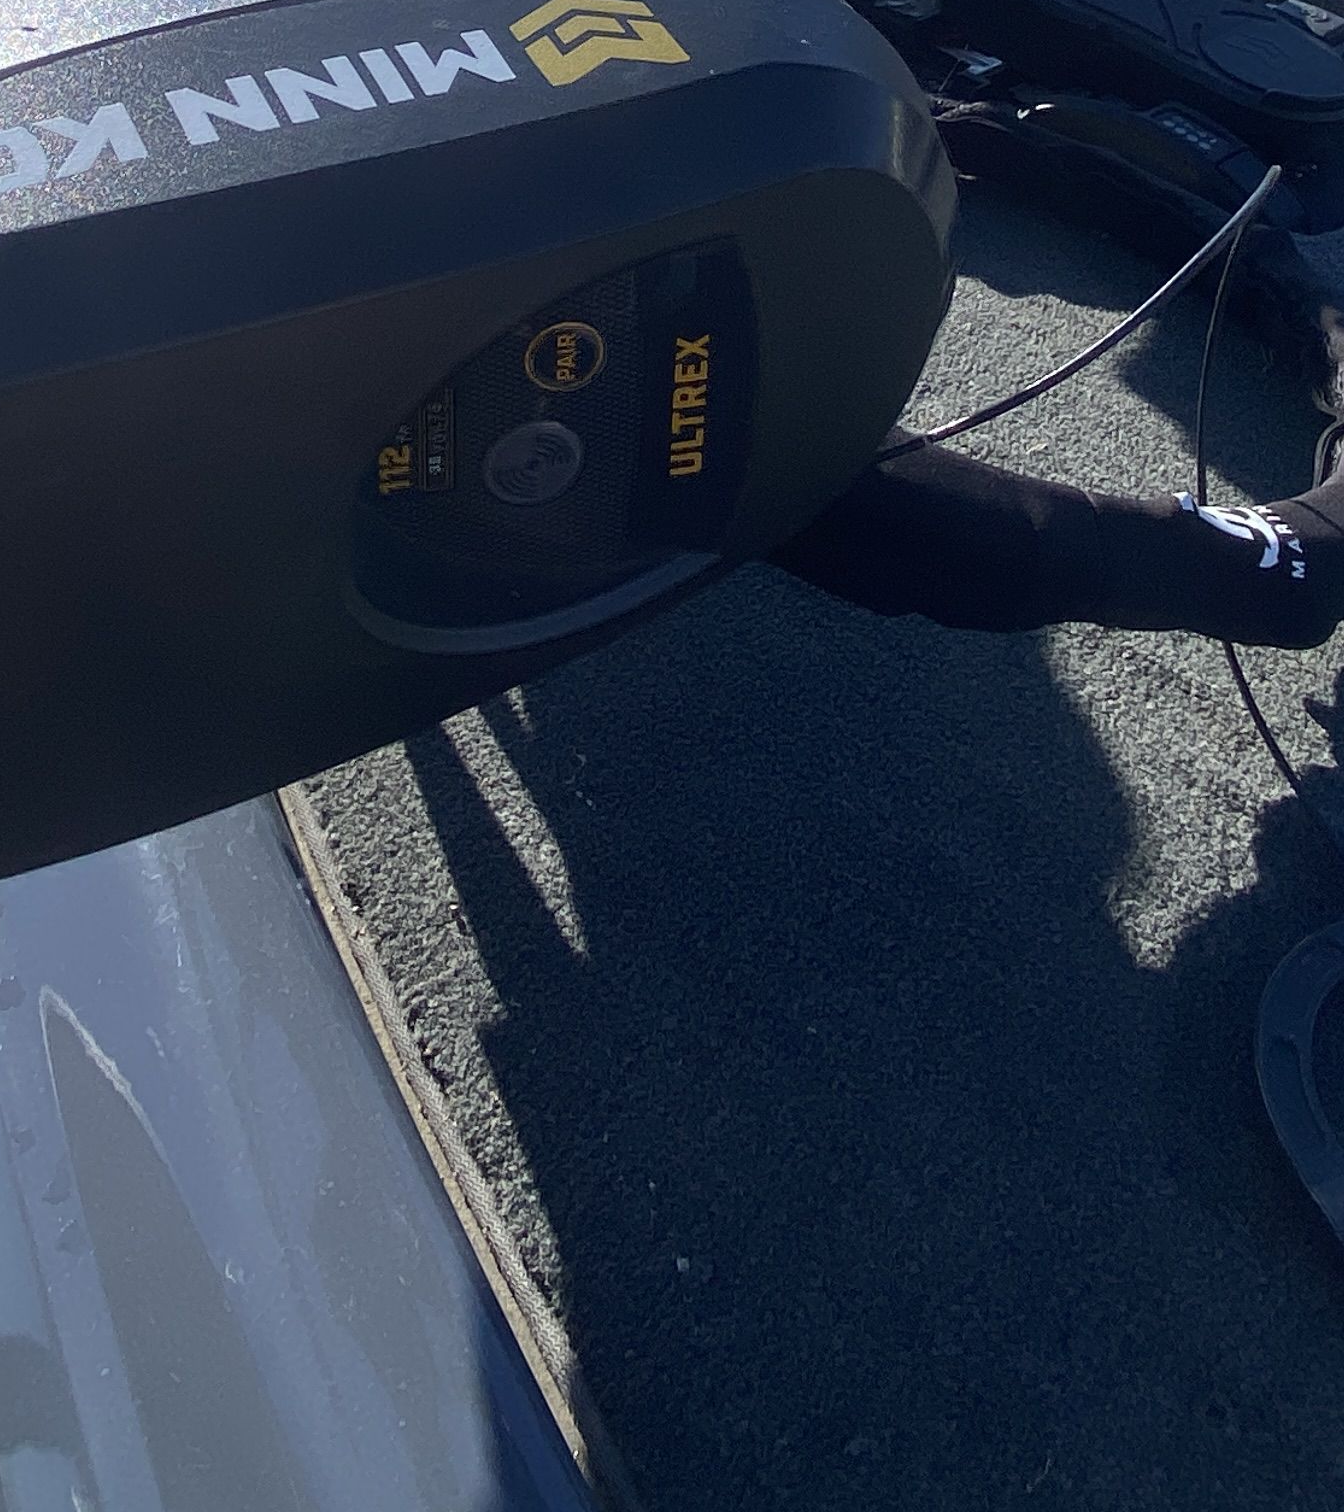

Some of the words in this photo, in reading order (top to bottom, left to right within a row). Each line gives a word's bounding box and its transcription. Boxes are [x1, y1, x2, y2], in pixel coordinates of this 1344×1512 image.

[167, 28, 516, 146] MINN
[556, 330, 578, 383] PAIR
[669, 334, 711, 478] ULTREX
[378, 445, 413, 495] 112
